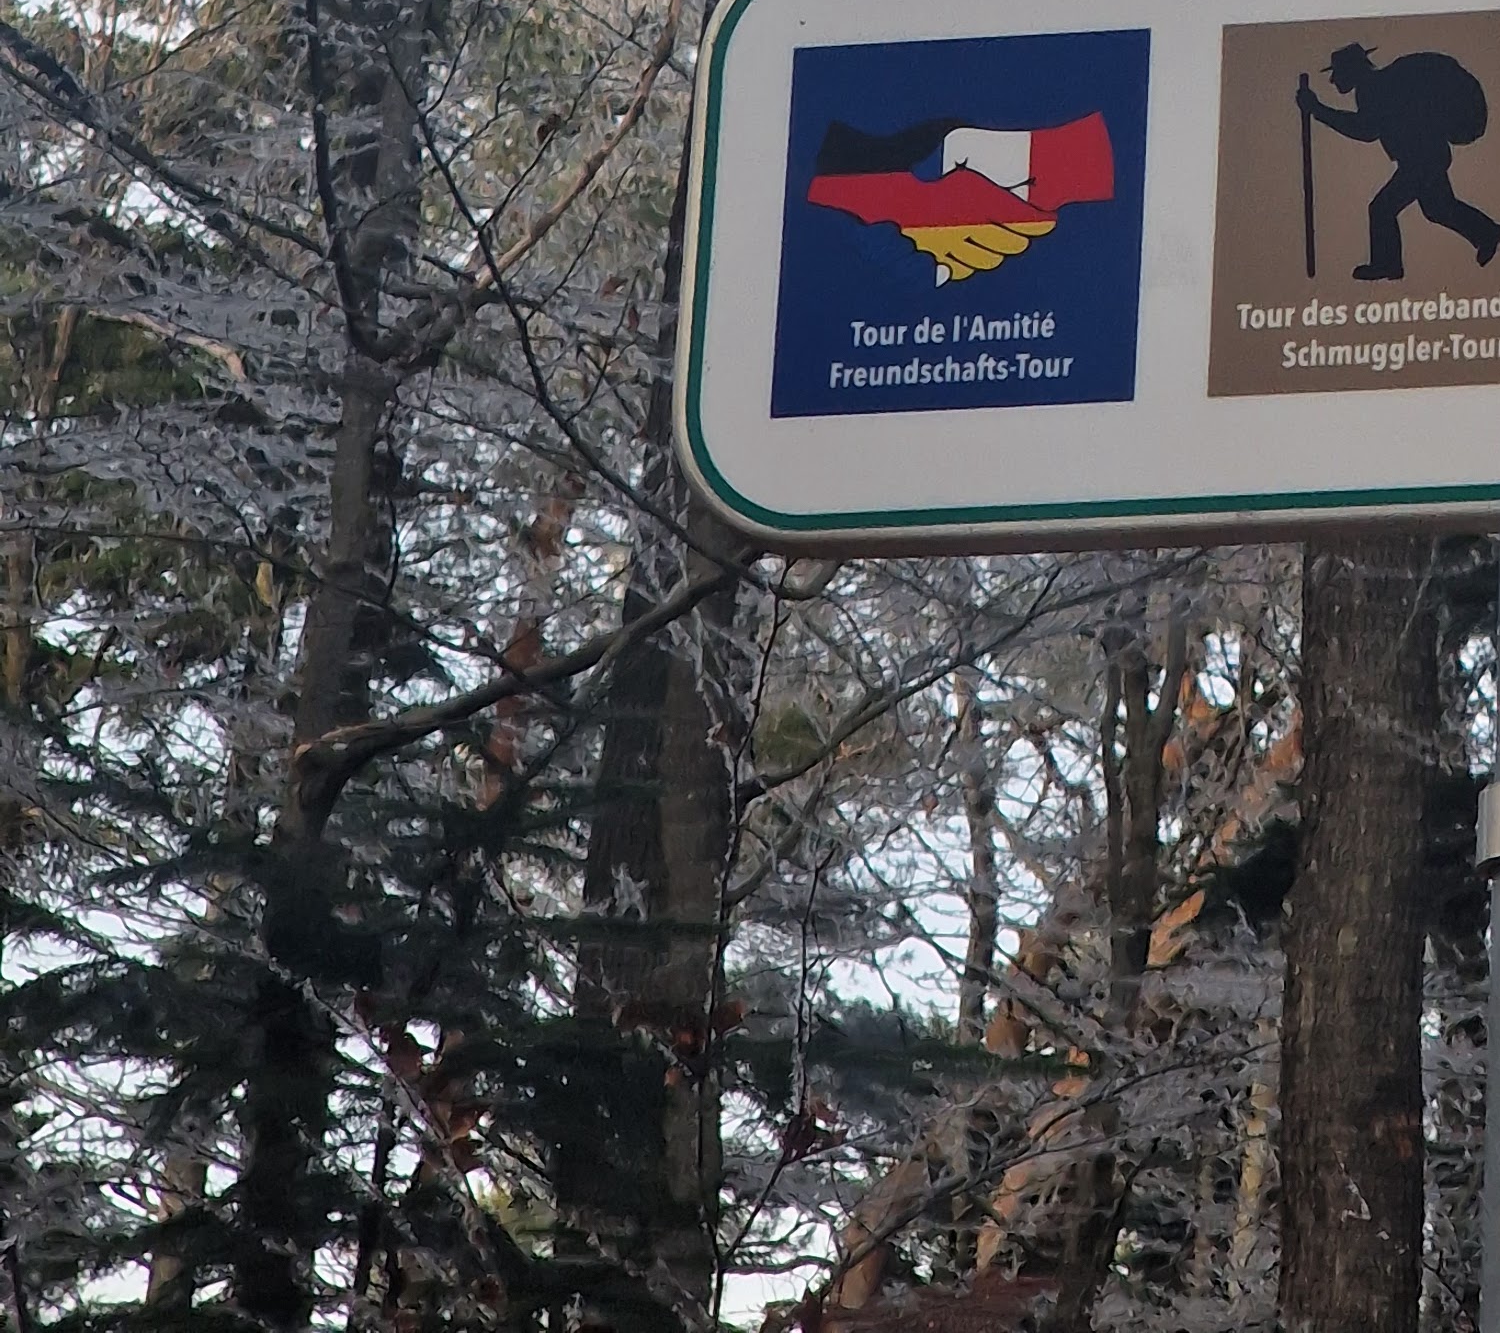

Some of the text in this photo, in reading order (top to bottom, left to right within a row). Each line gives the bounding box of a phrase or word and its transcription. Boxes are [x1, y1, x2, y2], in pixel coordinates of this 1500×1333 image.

[850, 310, 1057, 347] Tour de l'Amitié
[1236, 303, 1296, 330] Tour
[1301, 298, 1349, 327] des
[829, 353, 1075, 389] Freundschafts-Tour
